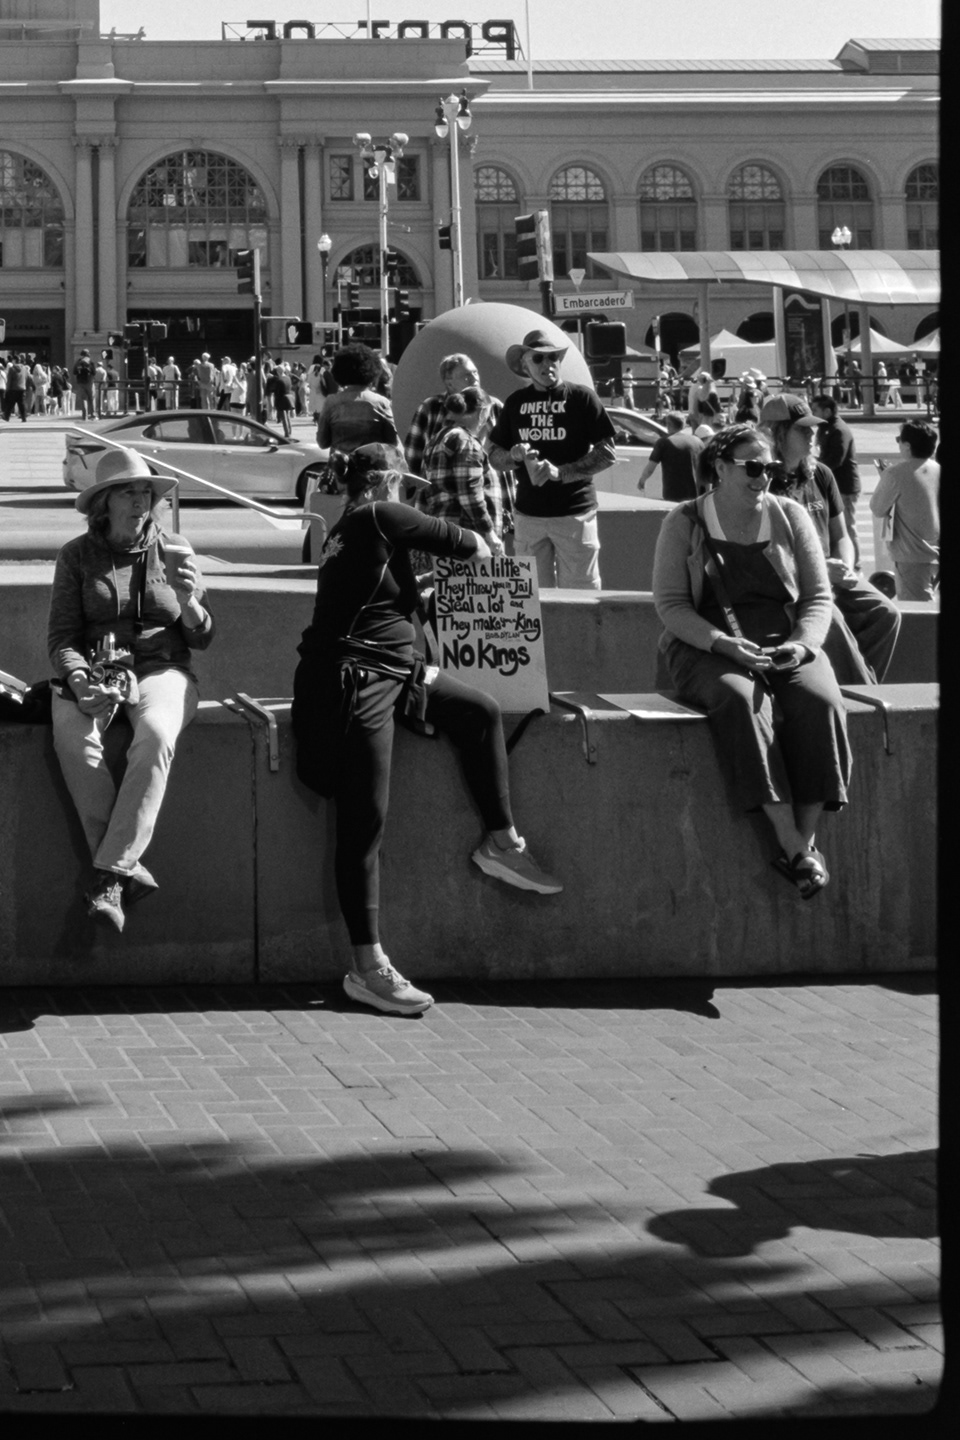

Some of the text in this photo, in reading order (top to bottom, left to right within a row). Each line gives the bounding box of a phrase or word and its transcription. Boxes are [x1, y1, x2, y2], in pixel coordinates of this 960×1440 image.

[563, 296, 626, 309] Embarcadero
[530, 414, 553, 427] THE
[518, 427, 566, 441] WORLD
[436, 557, 477, 578] Steal
[481, 564, 489, 577] a
[434, 578, 465, 601] They
[508, 578, 533, 596] Jail
[437, 595, 474, 614] Steal
[477, 602, 486, 613] a
[487, 594, 504, 613] lot
[437, 614, 470, 640] They
[515, 611, 541, 642] King
